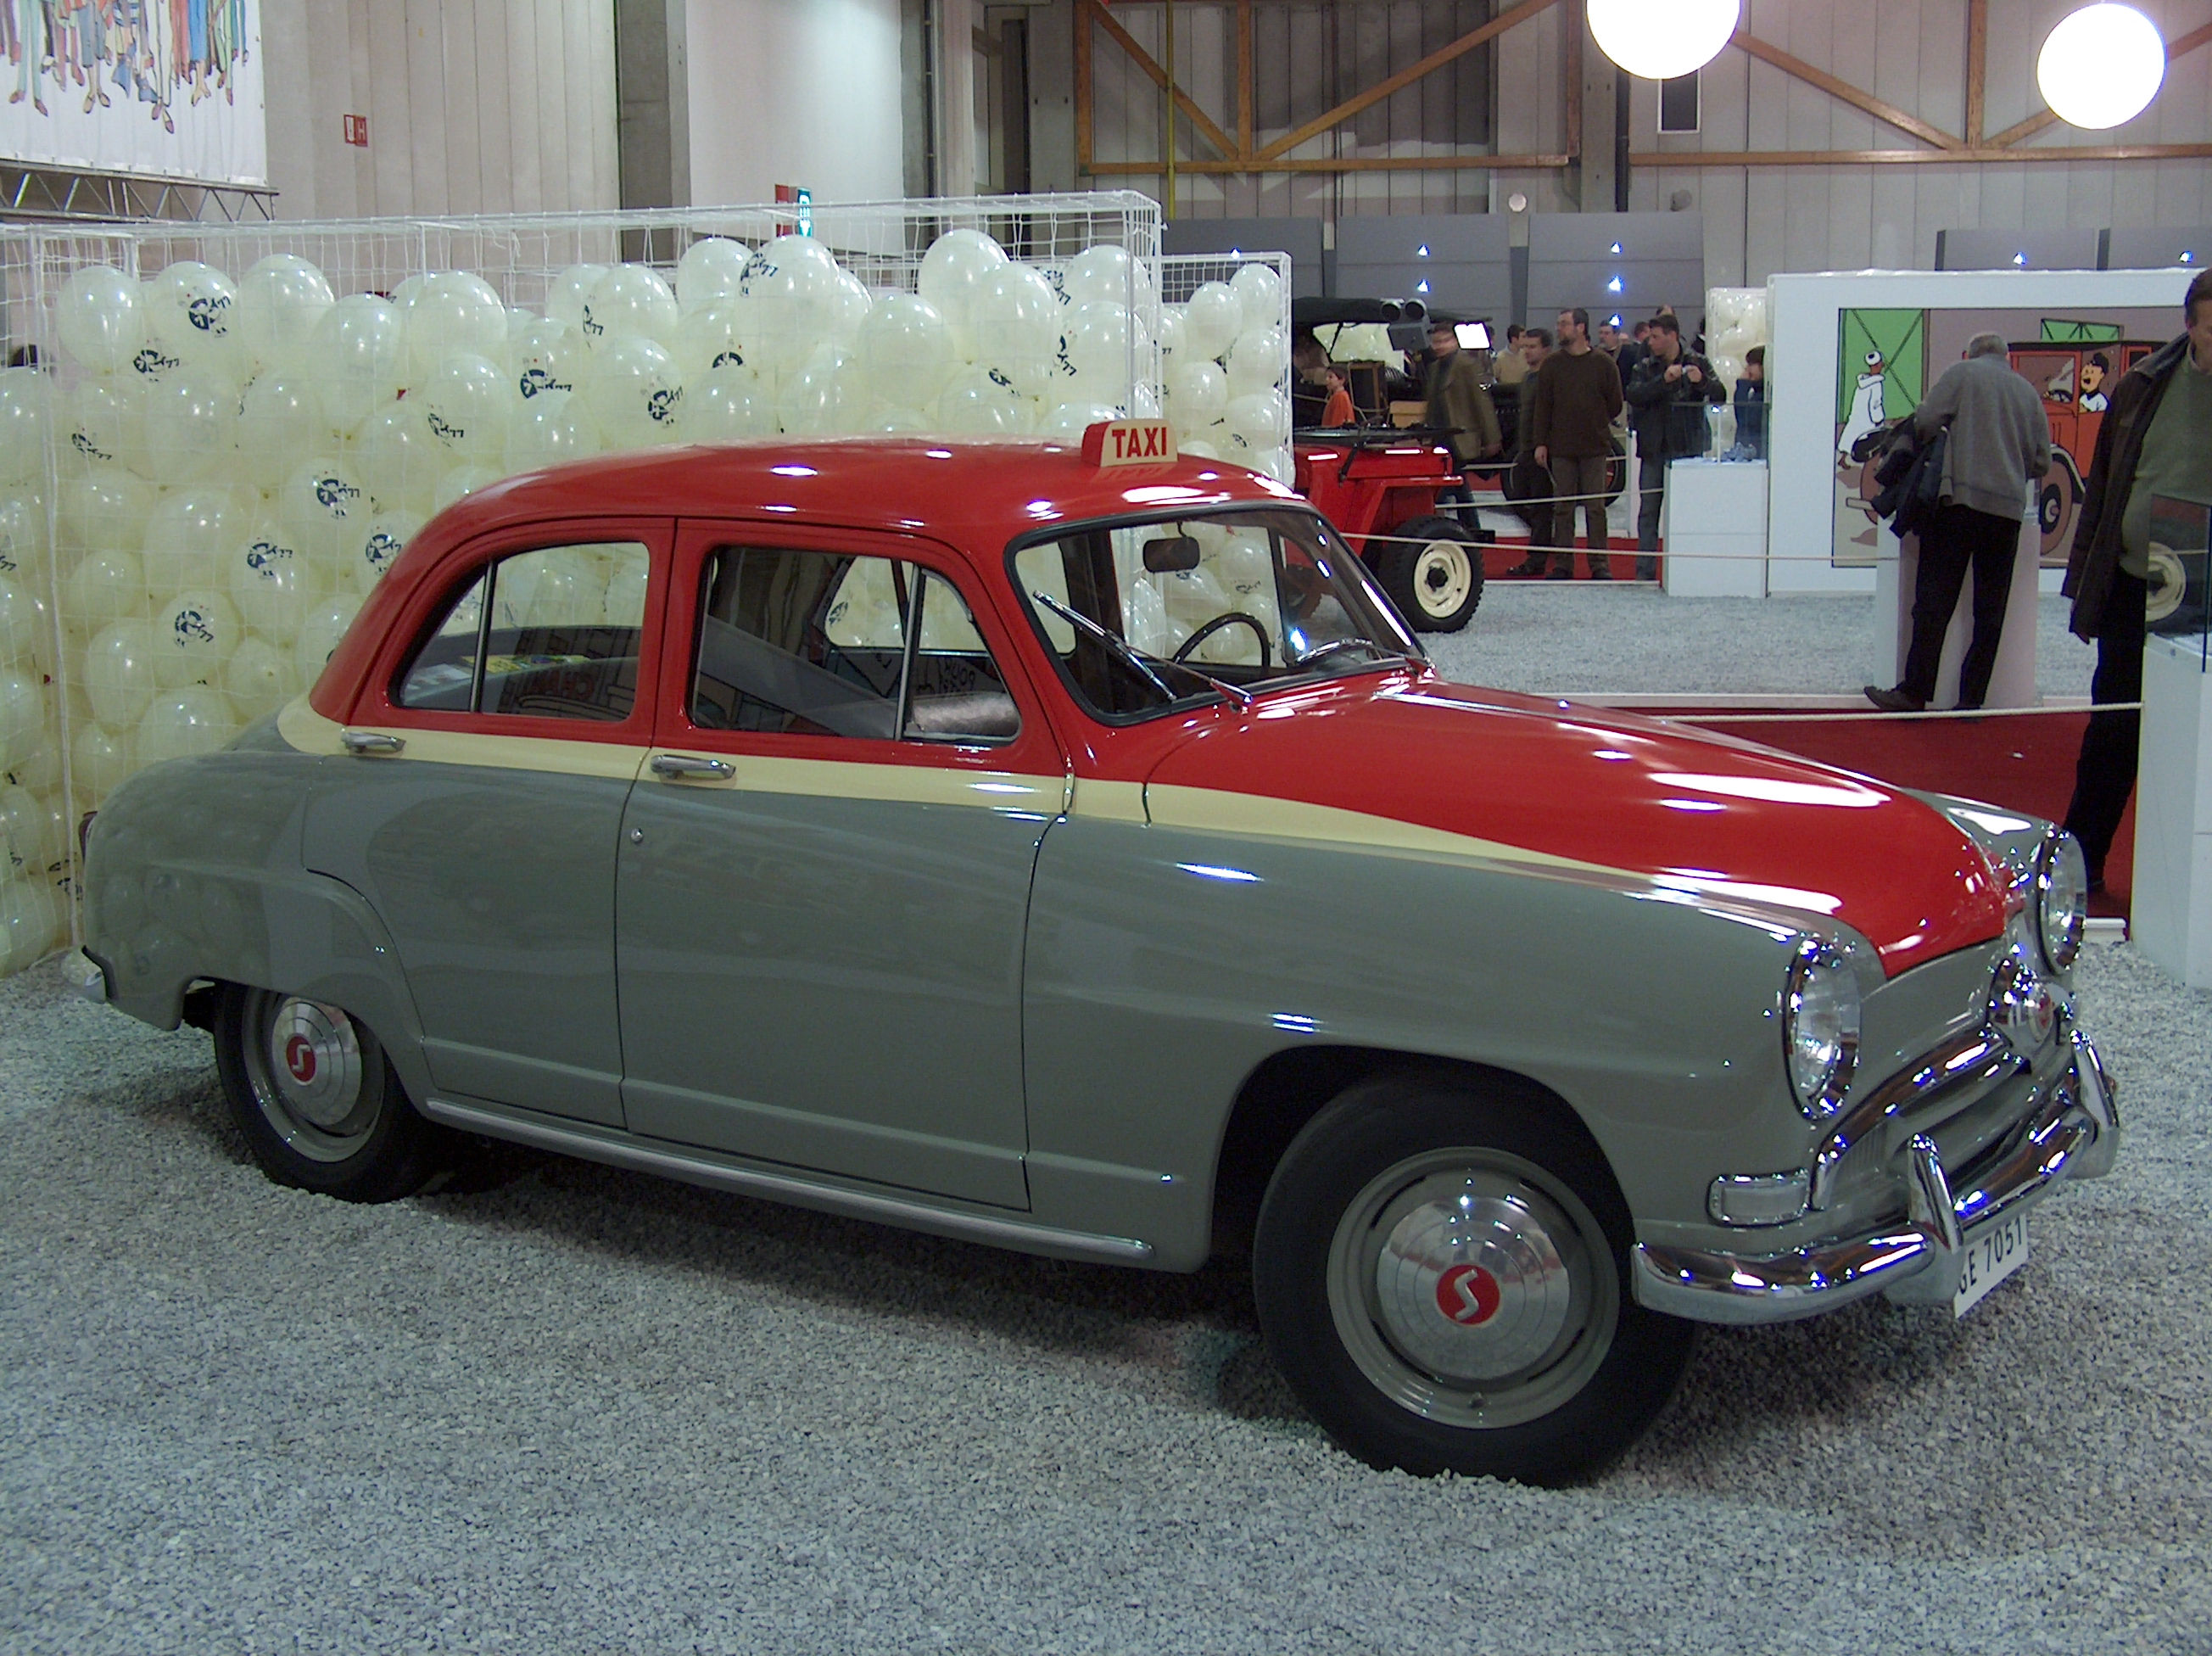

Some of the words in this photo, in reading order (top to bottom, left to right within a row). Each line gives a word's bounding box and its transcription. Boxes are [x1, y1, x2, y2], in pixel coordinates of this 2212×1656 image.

[1112, 427, 1167, 459] TAXI
[1984, 1216, 2022, 1273] 7051
[1454, 1268, 1480, 1322] S
